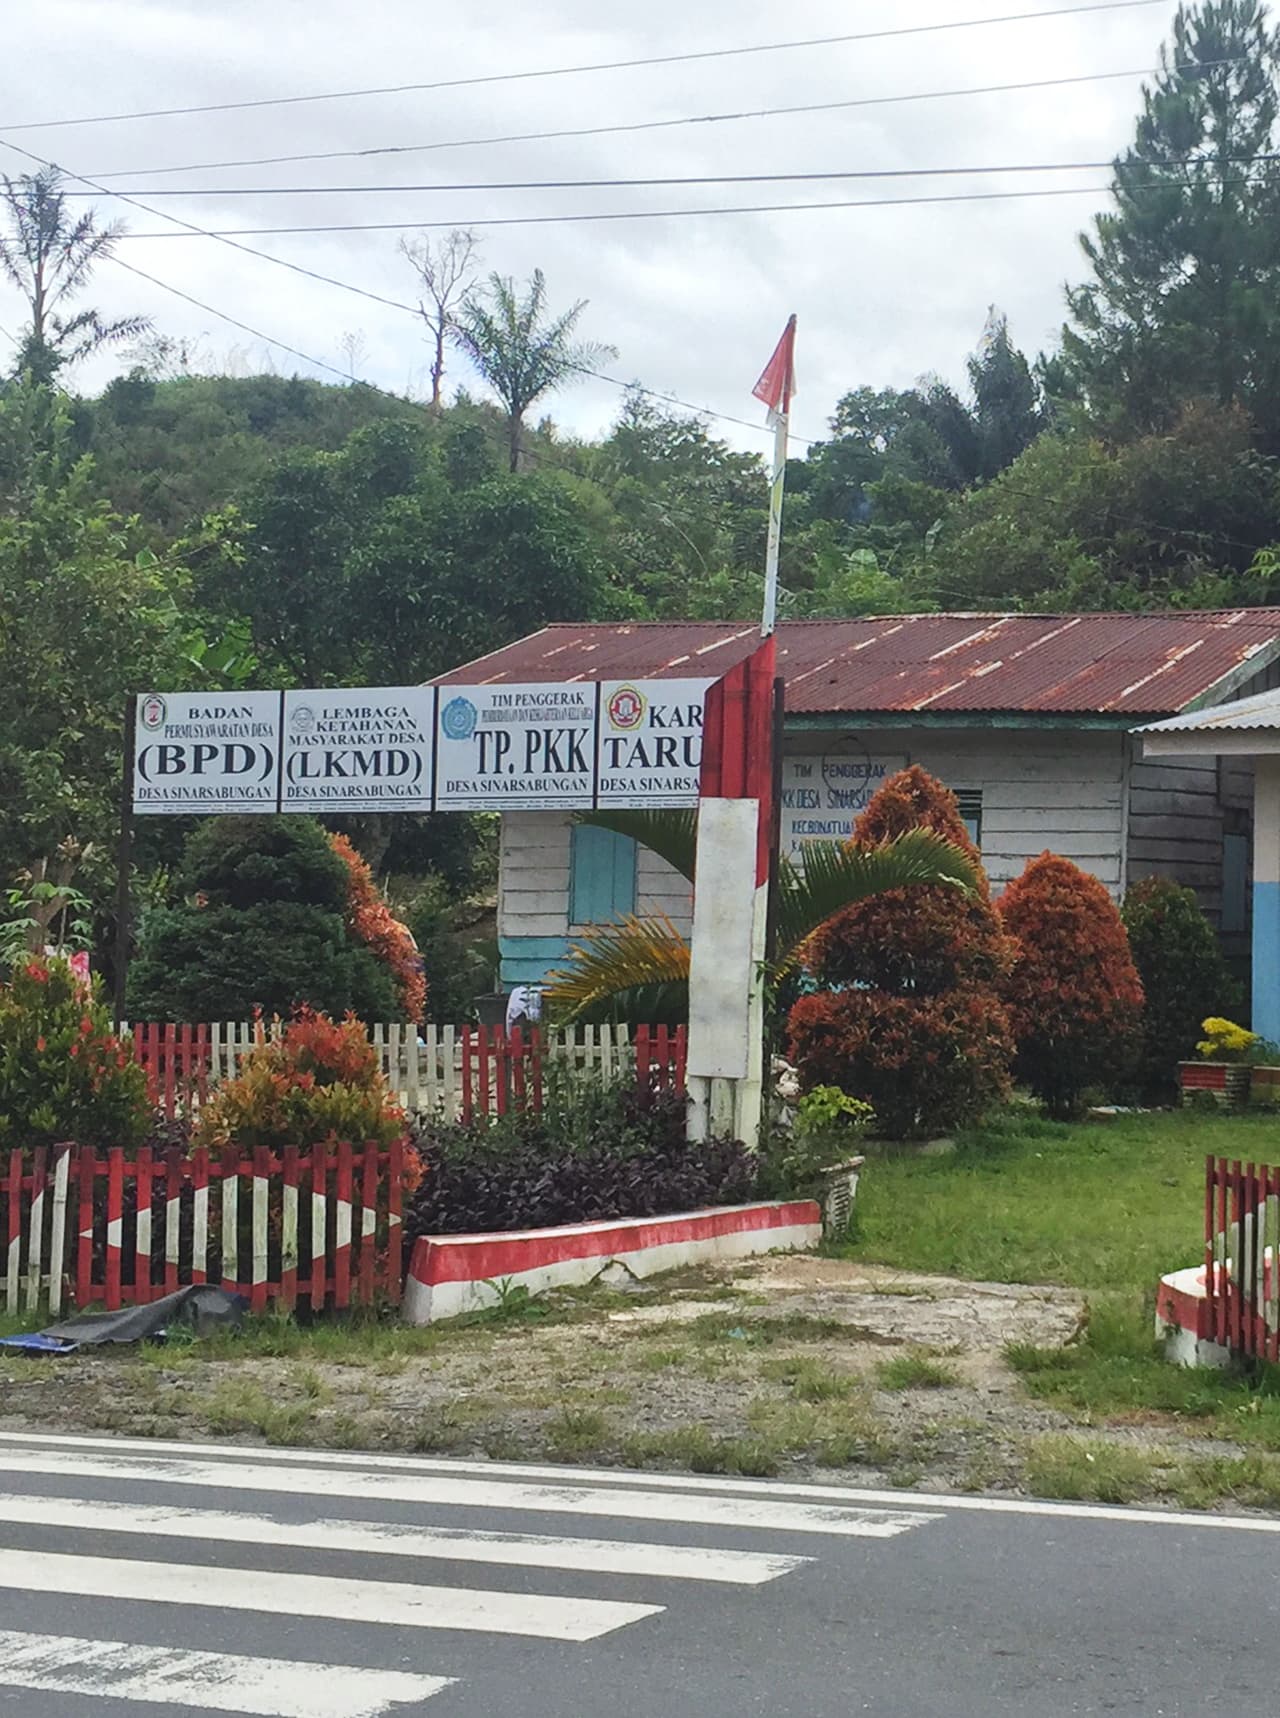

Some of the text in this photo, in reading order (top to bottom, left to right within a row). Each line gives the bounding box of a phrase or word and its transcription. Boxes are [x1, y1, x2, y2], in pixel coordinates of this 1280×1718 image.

[491, 692, 585, 707] TIM PENGGERAK
[188, 706, 253, 720] BADAN
[322, 707, 409, 720] LEMBAGA
[649, 704, 703, 728] KAR
[164, 722, 274, 739] PERMUSYAWARATAN DESA
[316, 719, 417, 732] KETAHANAN
[289, 733, 425, 746] MASYARAKAT DESA
[474, 728, 590, 774] TP. PKK
[604, 735, 703, 769] TARU
[138, 743, 273, 783] (BPD)
[286, 749, 423, 784] (LKMD)
[793, 764, 885, 778] TIM PENGGERAK
[287, 785, 422, 798] DESA SINARSABUNGAN
[446, 779, 587, 793] DESA SINARSABUNGAN
[600, 778, 637, 792] DESA
[139, 786, 271, 800] DESA SINARSABUNGAN
[797, 788, 820, 809] DESA
